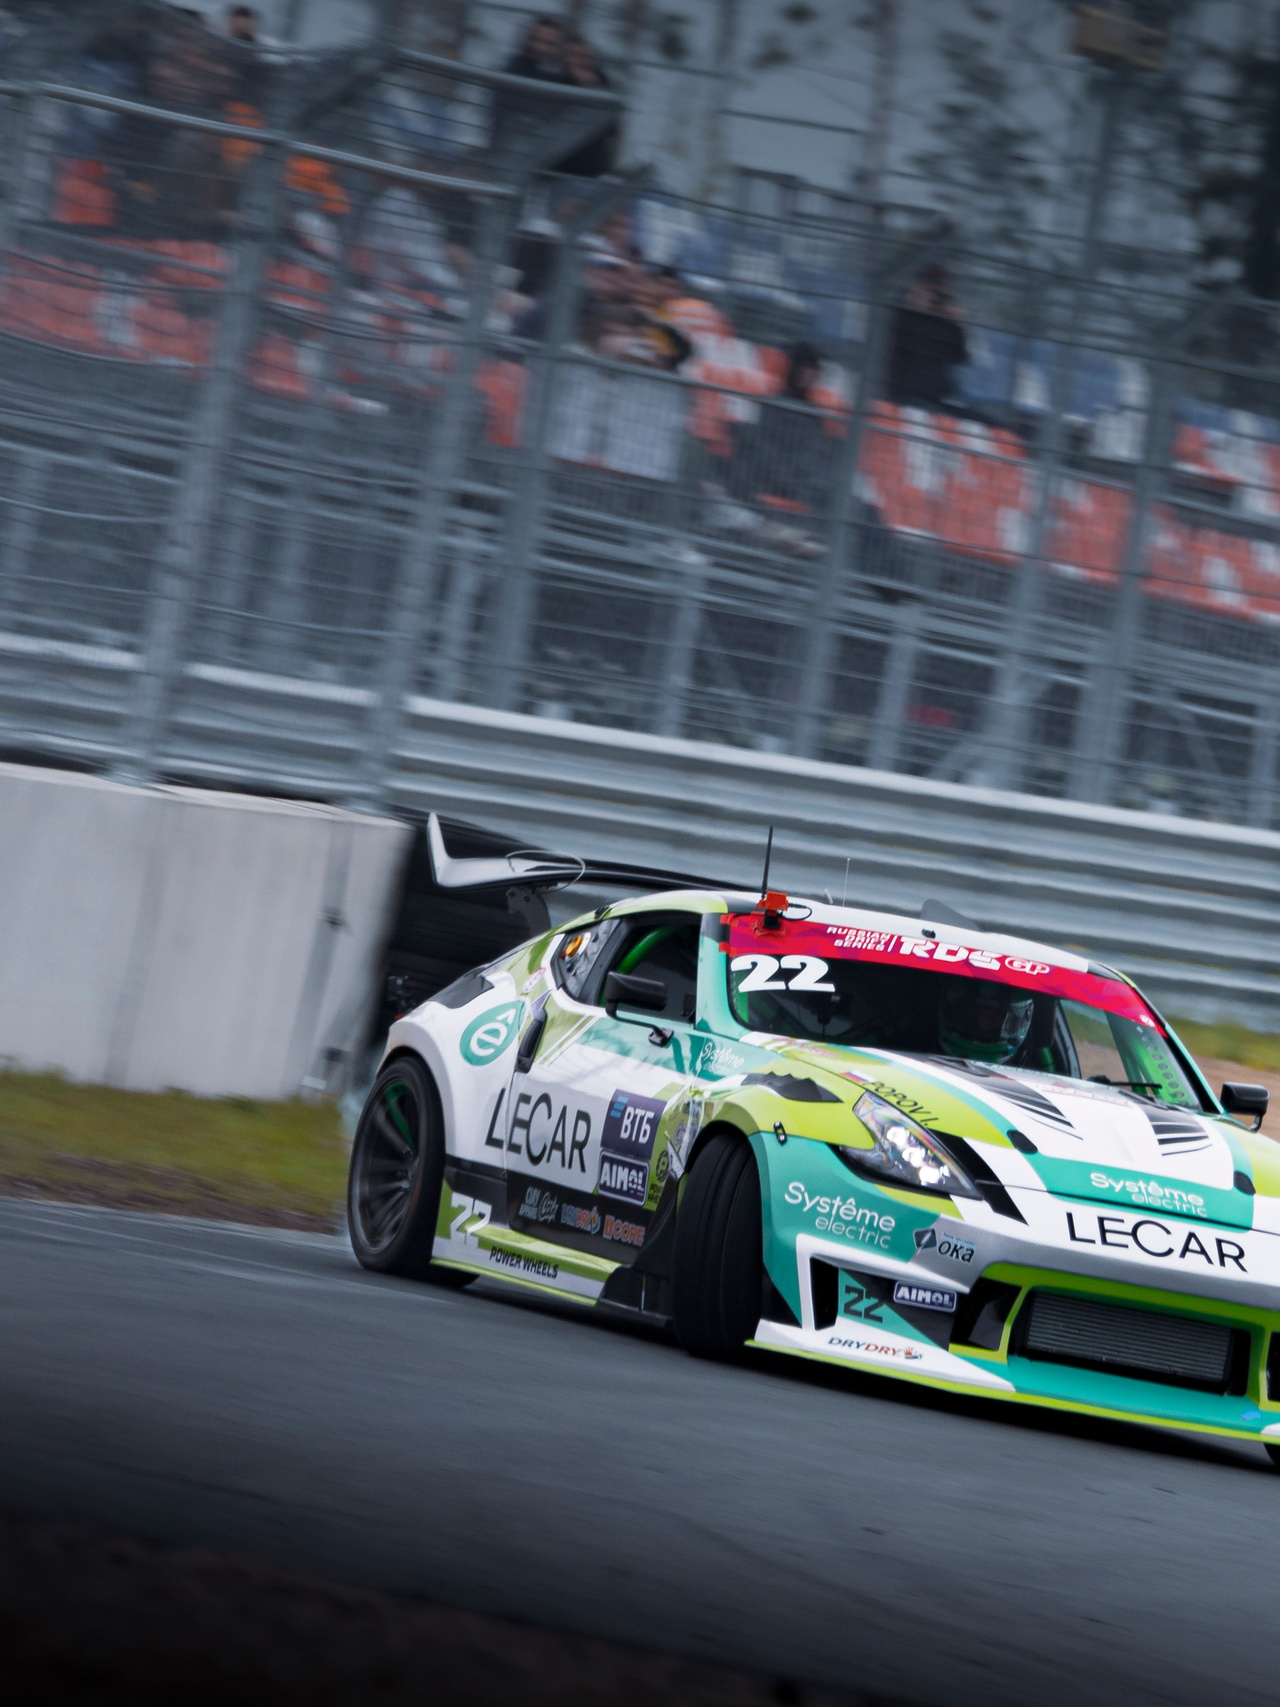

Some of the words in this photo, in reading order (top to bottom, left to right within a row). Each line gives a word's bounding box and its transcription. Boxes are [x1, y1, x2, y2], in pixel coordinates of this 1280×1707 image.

[827, 926, 891, 941] RUSSIAN
[834, 939, 885, 951] SERIES
[845, 933, 887, 945] DRIFT
[899, 936, 1003, 971] RDS
[730, 954, 836, 993] 22
[701, 1042, 745, 1067] Système
[862, 1081, 932, 1114] POPOV
[485, 1087, 592, 1173] LECAR
[620, 1106, 655, 1145] ВТБ
[600, 1162, 645, 1192] AIMOL
[1090, 1172, 1204, 1206] Système
[784, 1181, 896, 1233] Système
[1131, 1193, 1208, 1218] electric
[815, 1215, 892, 1249] electric
[1065, 1211, 1248, 1273] LECAR
[490, 1246, 524, 1270] POWER
[521, 1256, 559, 1280] WHEELS
[844, 1285, 883, 1323] 22
[896, 1286, 953, 1305] AIMOL
